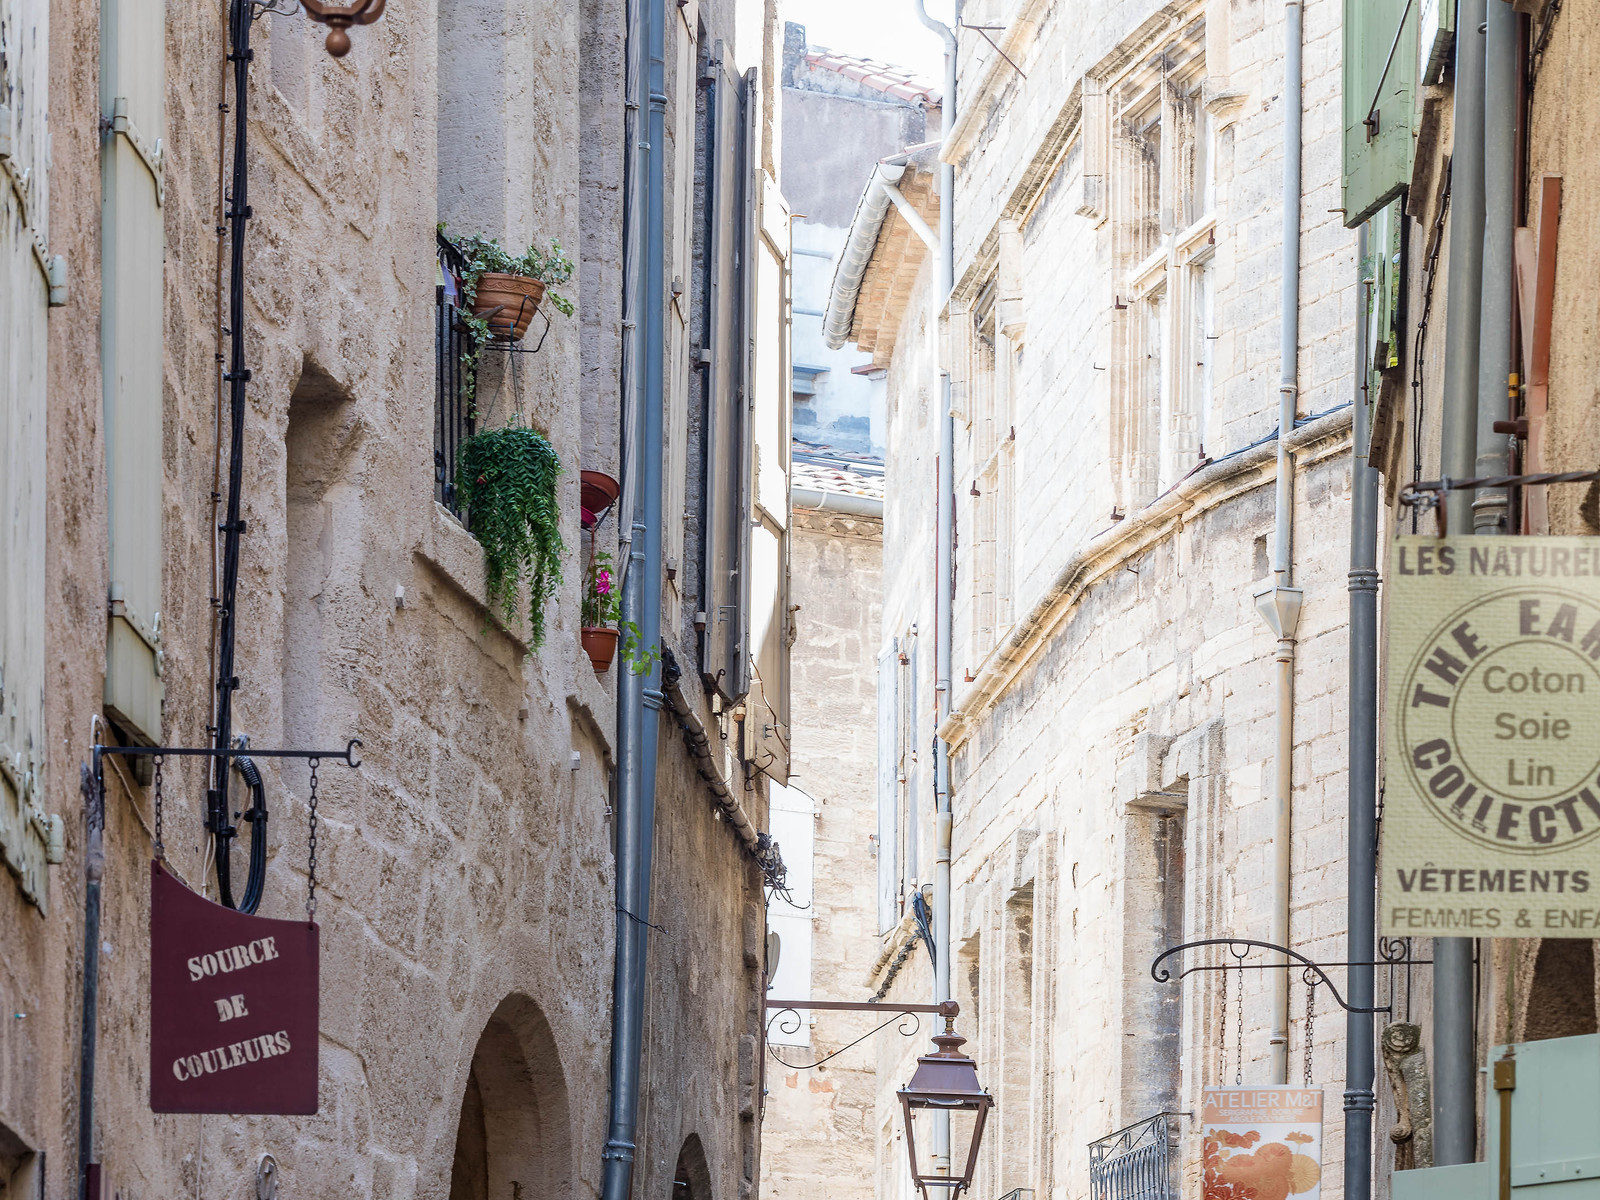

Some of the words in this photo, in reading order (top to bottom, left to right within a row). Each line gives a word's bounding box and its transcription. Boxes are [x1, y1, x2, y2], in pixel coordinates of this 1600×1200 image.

[1398, 546, 1455, 576] LES
[1411, 620, 1488, 708] THE
[1483, 665, 1585, 694] Coton
[1495, 712, 1571, 740] Soie
[1508, 758, 1555, 786] Lin
[1412, 738, 1600, 844] COLLECTI
[1397, 862, 1590, 893] VÊTEMENTS
[1391, 907, 1501, 928] FEMMES
[1514, 908, 1531, 928] &
[187, 936, 279, 981] SOURCE
[214, 994, 249, 1022] DE
[172, 1030, 291, 1081] COULEURS
[1205, 1092, 1280, 1108] ATELIER
[1286, 1091, 1321, 1108] M&T
